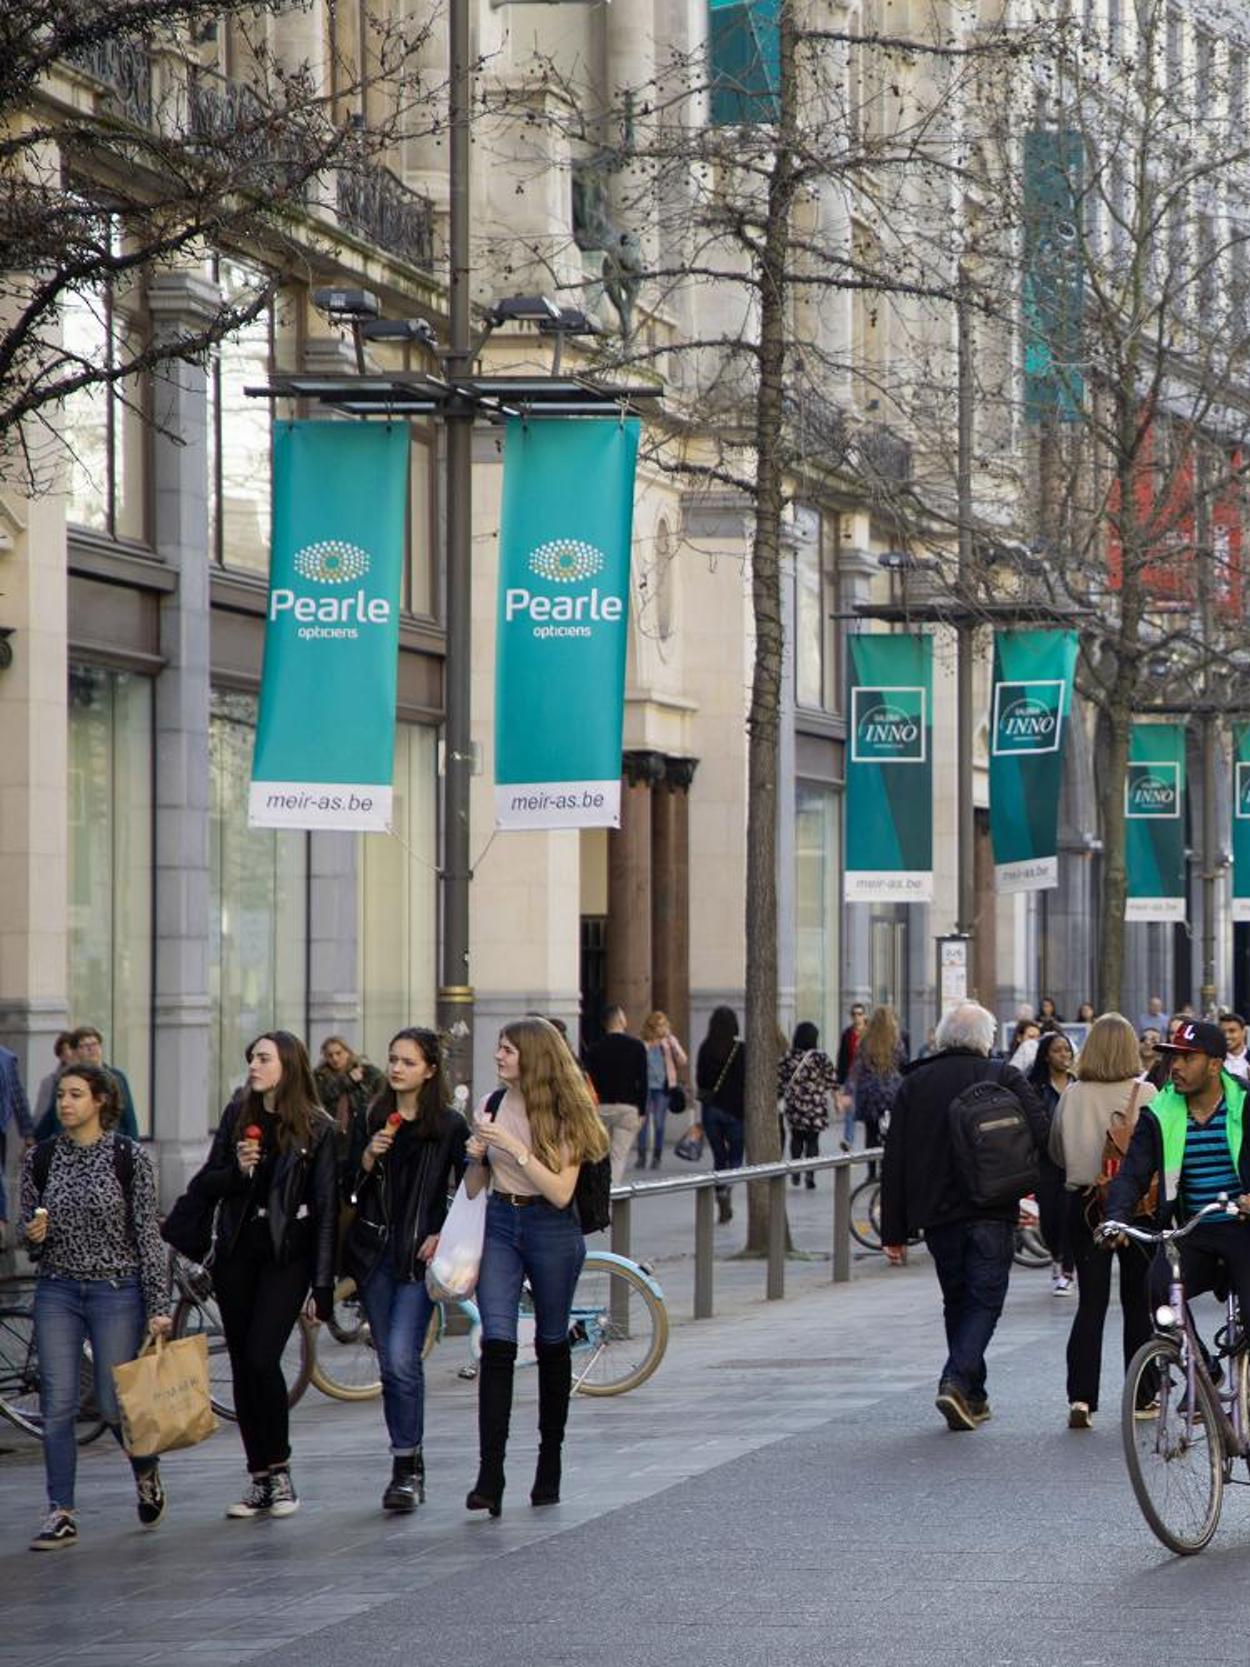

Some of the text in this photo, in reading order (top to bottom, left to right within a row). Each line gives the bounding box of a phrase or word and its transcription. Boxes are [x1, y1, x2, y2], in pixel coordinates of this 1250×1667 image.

[270, 587, 390, 624] Pearle
[505, 586, 623, 622] Pearle
[297, 626, 358, 640] opticiens
[533, 624, 592, 639] opticiens
[866, 724, 918, 743] INNO
[1006, 716, 1055, 735] INNO
[266, 792, 373, 812] meir-as.be
[510, 790, 604, 810] meir-as.be
[1134, 789, 1174, 803] INNO
